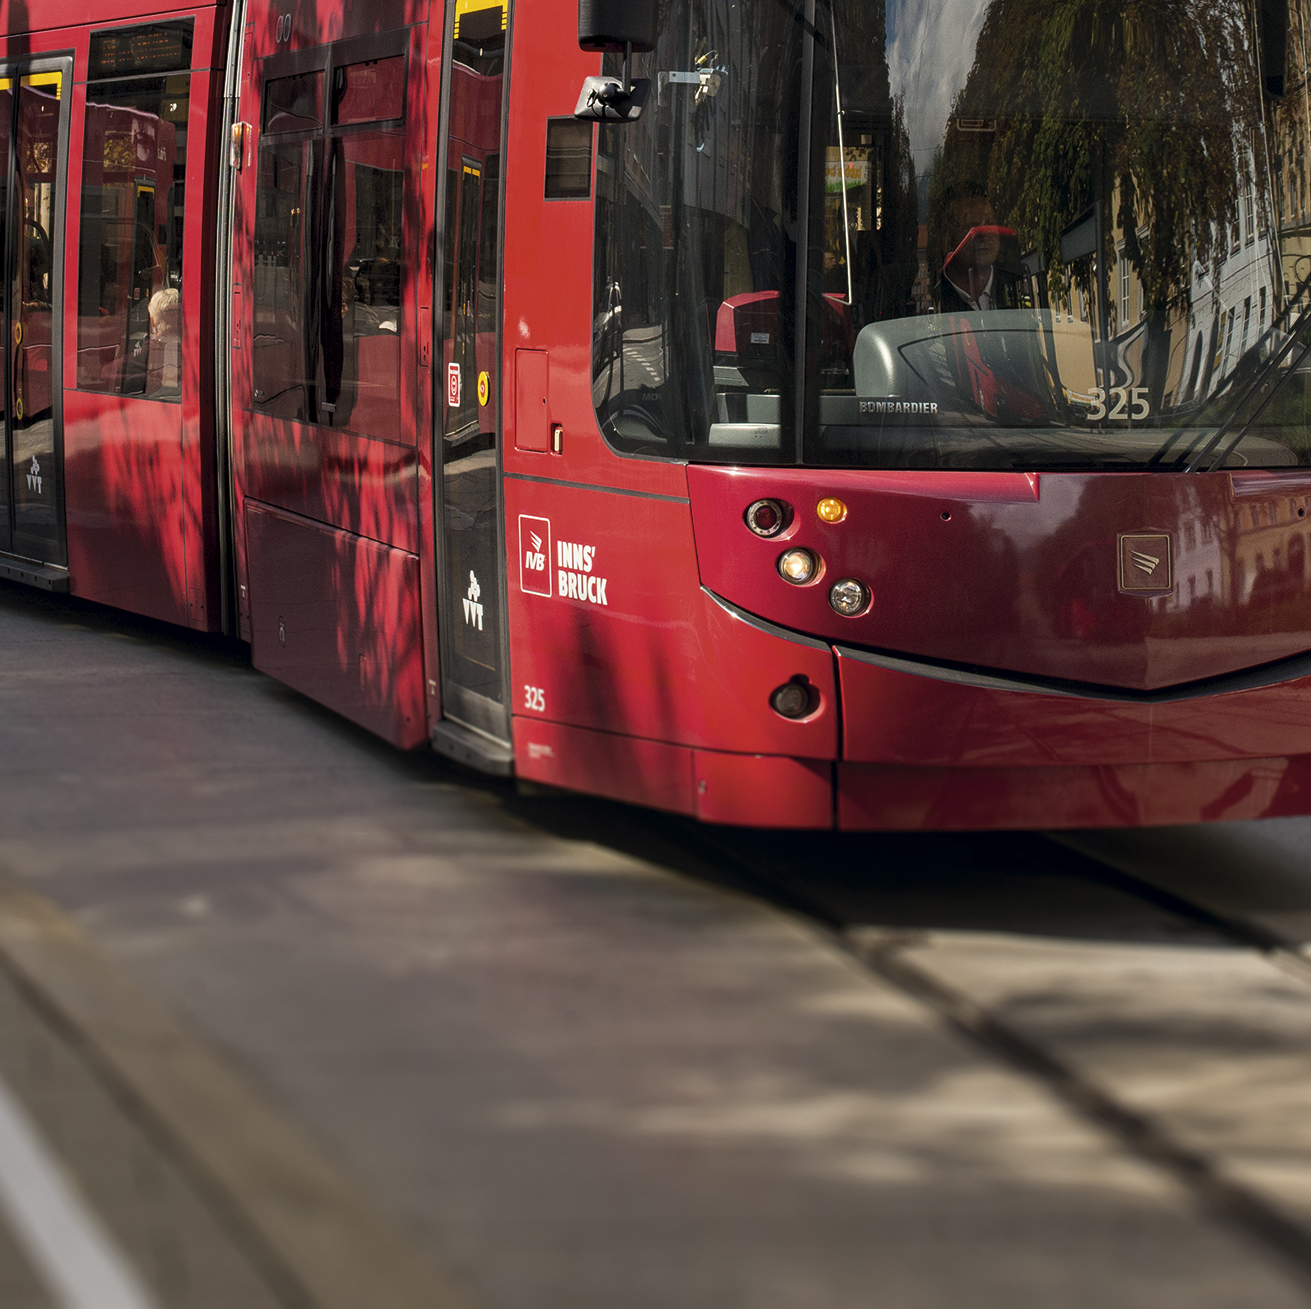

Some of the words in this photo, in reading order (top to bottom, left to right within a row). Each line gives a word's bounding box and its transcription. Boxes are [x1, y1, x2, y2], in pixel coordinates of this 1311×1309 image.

[859, 401, 938, 414] BOMBARDIER
[1086, 386, 1150, 421] 325
[525, 550, 546, 572] IVB
[558, 569, 608, 606] BRUCK
[524, 684, 546, 713] 325
